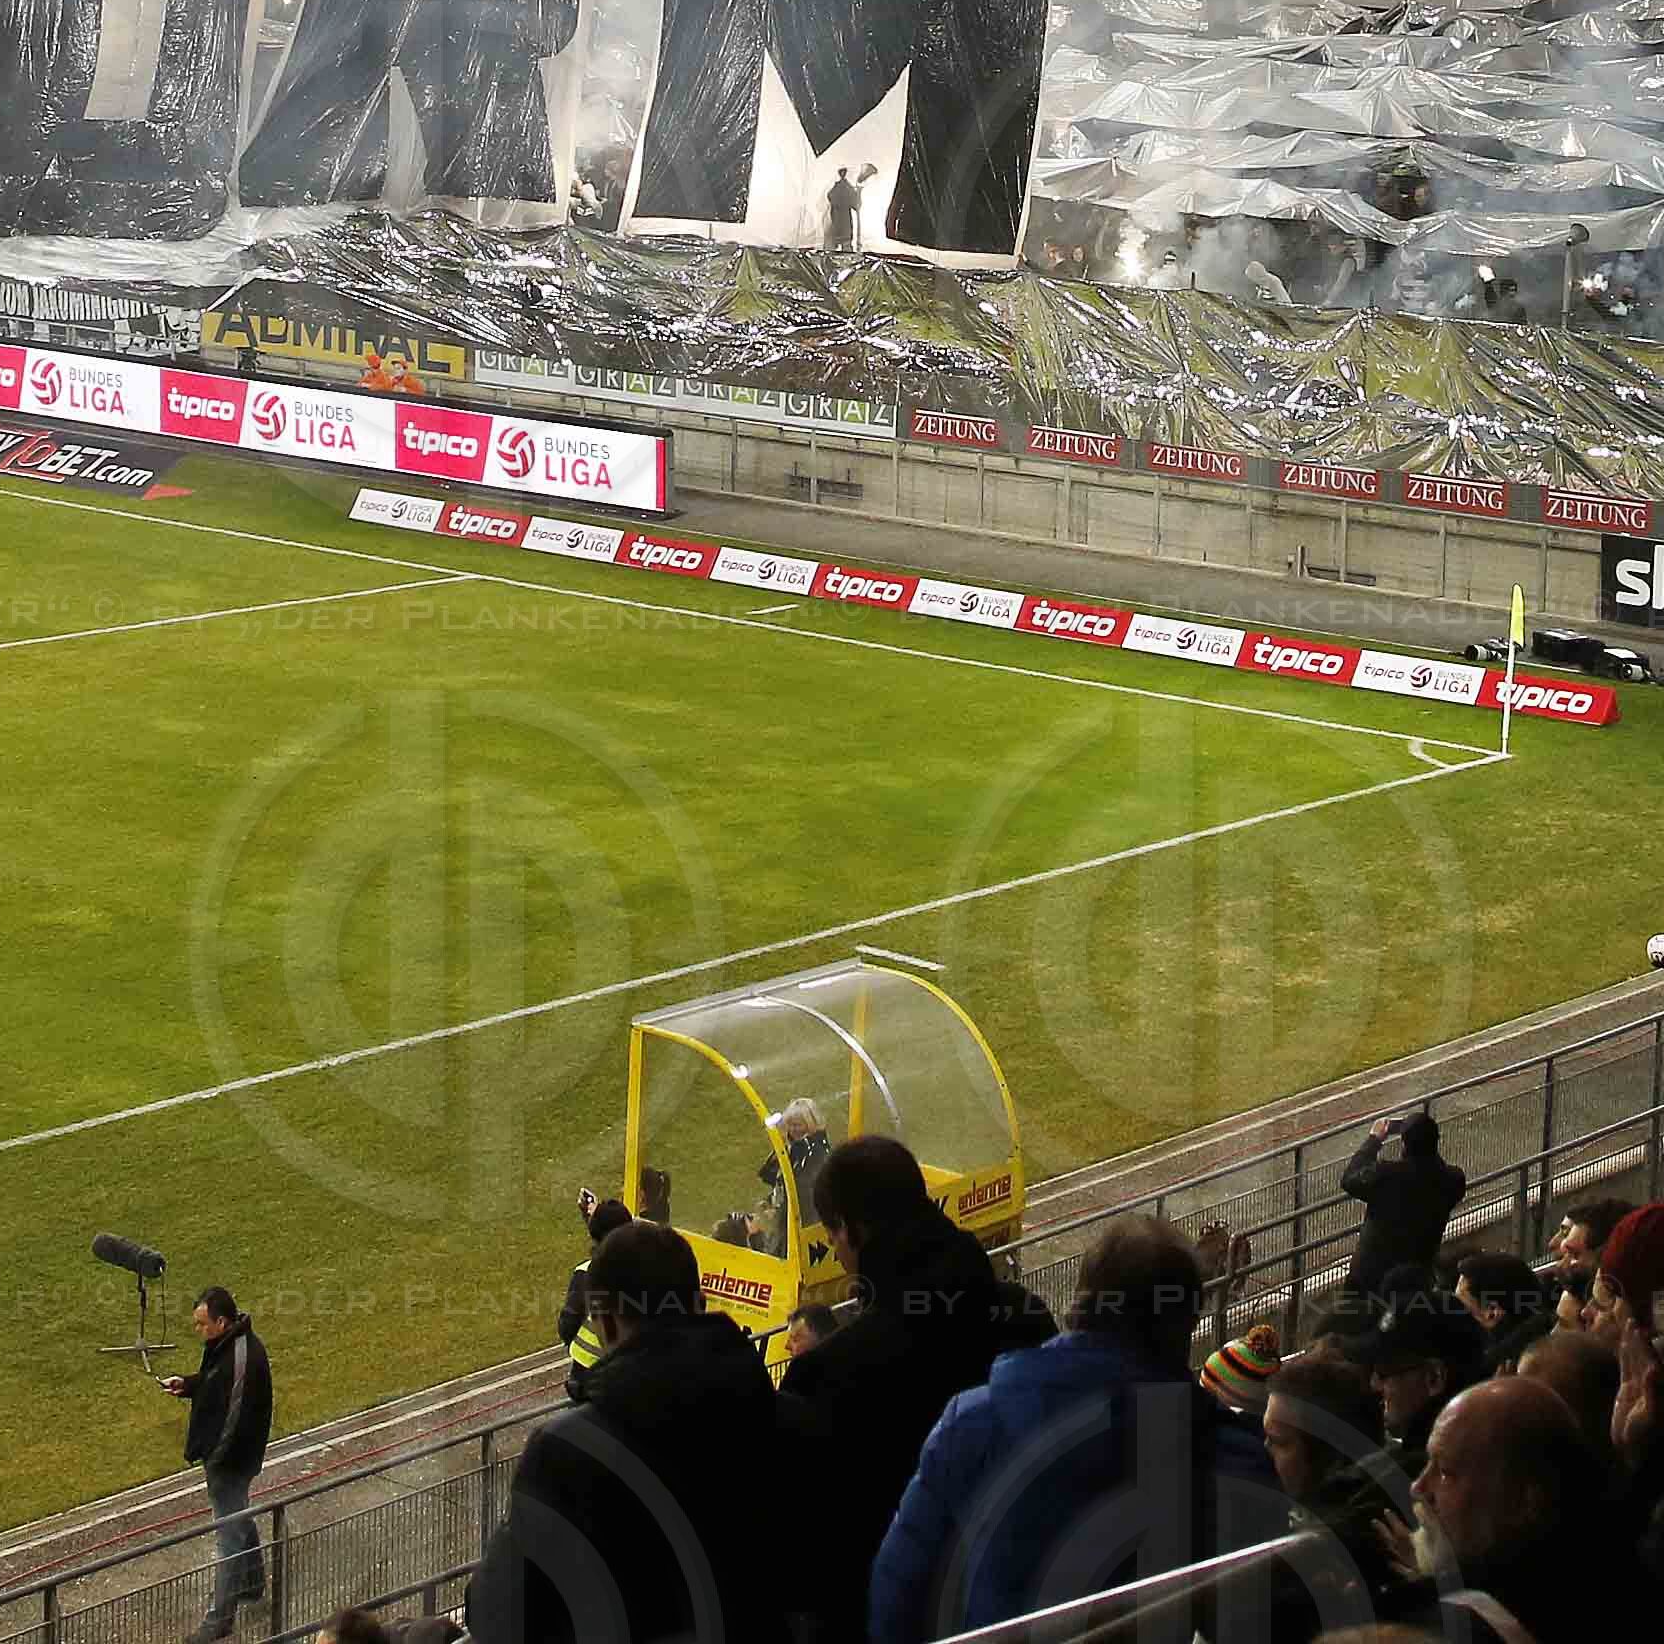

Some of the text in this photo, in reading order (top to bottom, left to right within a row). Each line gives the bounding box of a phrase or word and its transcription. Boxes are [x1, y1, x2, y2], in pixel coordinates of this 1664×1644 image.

[69, 366, 124, 389] BUNDES
[578, 366, 677, 397] GRAZ
[69, 385, 126, 416] LIGA
[166, 386, 236, 421] tipico
[294, 401, 355, 422] BUNDES
[786, 392, 892, 424] GRAZ
[294, 420, 357, 453] LIGA
[402, 421, 479, 458] tipico
[914, 414, 996, 442] ZEITUNG
[544, 437, 611, 461] BUNDES
[1031, 429, 1117, 460] ZEITUNG
[1152, 444, 1242, 476] ZEITUNG
[544, 457, 614, 491] LIGA
[1284, 463, 1378, 494] ZEITUNG
[1407, 478, 1505, 512] ZEITUNG
[448, 505, 518, 539] tipico
[1546, 496, 1647, 530] ZEITUNG
[584, 538, 613, 555] LIGA
[630, 535, 703, 570] tipico
[777, 570, 806, 587] LIGA
[824, 567, 904, 603] tipico
[920, 591, 956, 607] tipico
[978, 602, 1011, 620] LIGA
[1031, 600, 1117, 637] tipico
[1134, 626, 1172, 643] tipico
[1197, 640, 1232, 658] LIGA
[1253, 635, 1344, 676] tipico
[1364, 662, 1405, 680] tipico
[1433, 677, 1470, 695] LIGA
[1495, 674, 1594, 715] tipico
[700, 1267, 773, 1301] antenne
